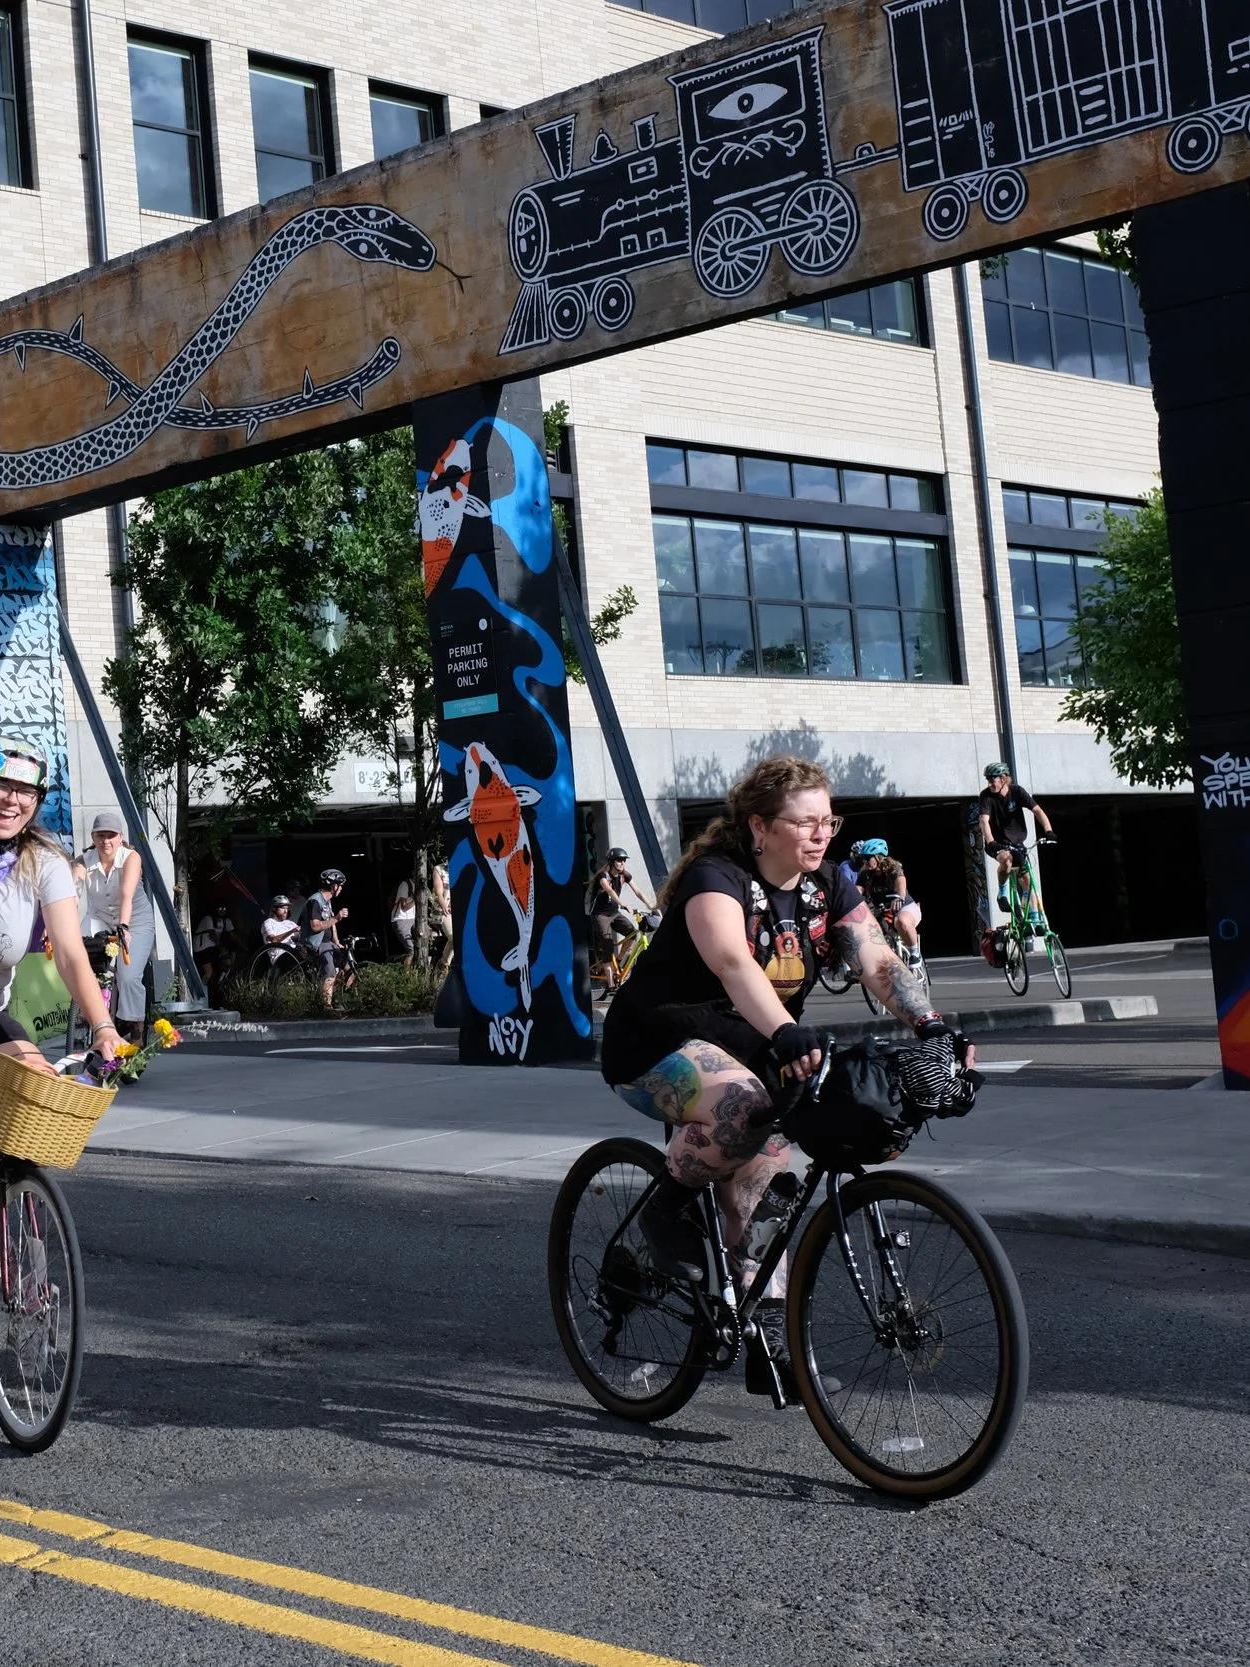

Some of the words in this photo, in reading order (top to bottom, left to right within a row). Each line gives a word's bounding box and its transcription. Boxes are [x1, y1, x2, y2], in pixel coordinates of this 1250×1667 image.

[449, 643, 483, 659] PERMIT
[447, 657, 488, 674] PARKING
[457, 674, 480, 688] ONLY
